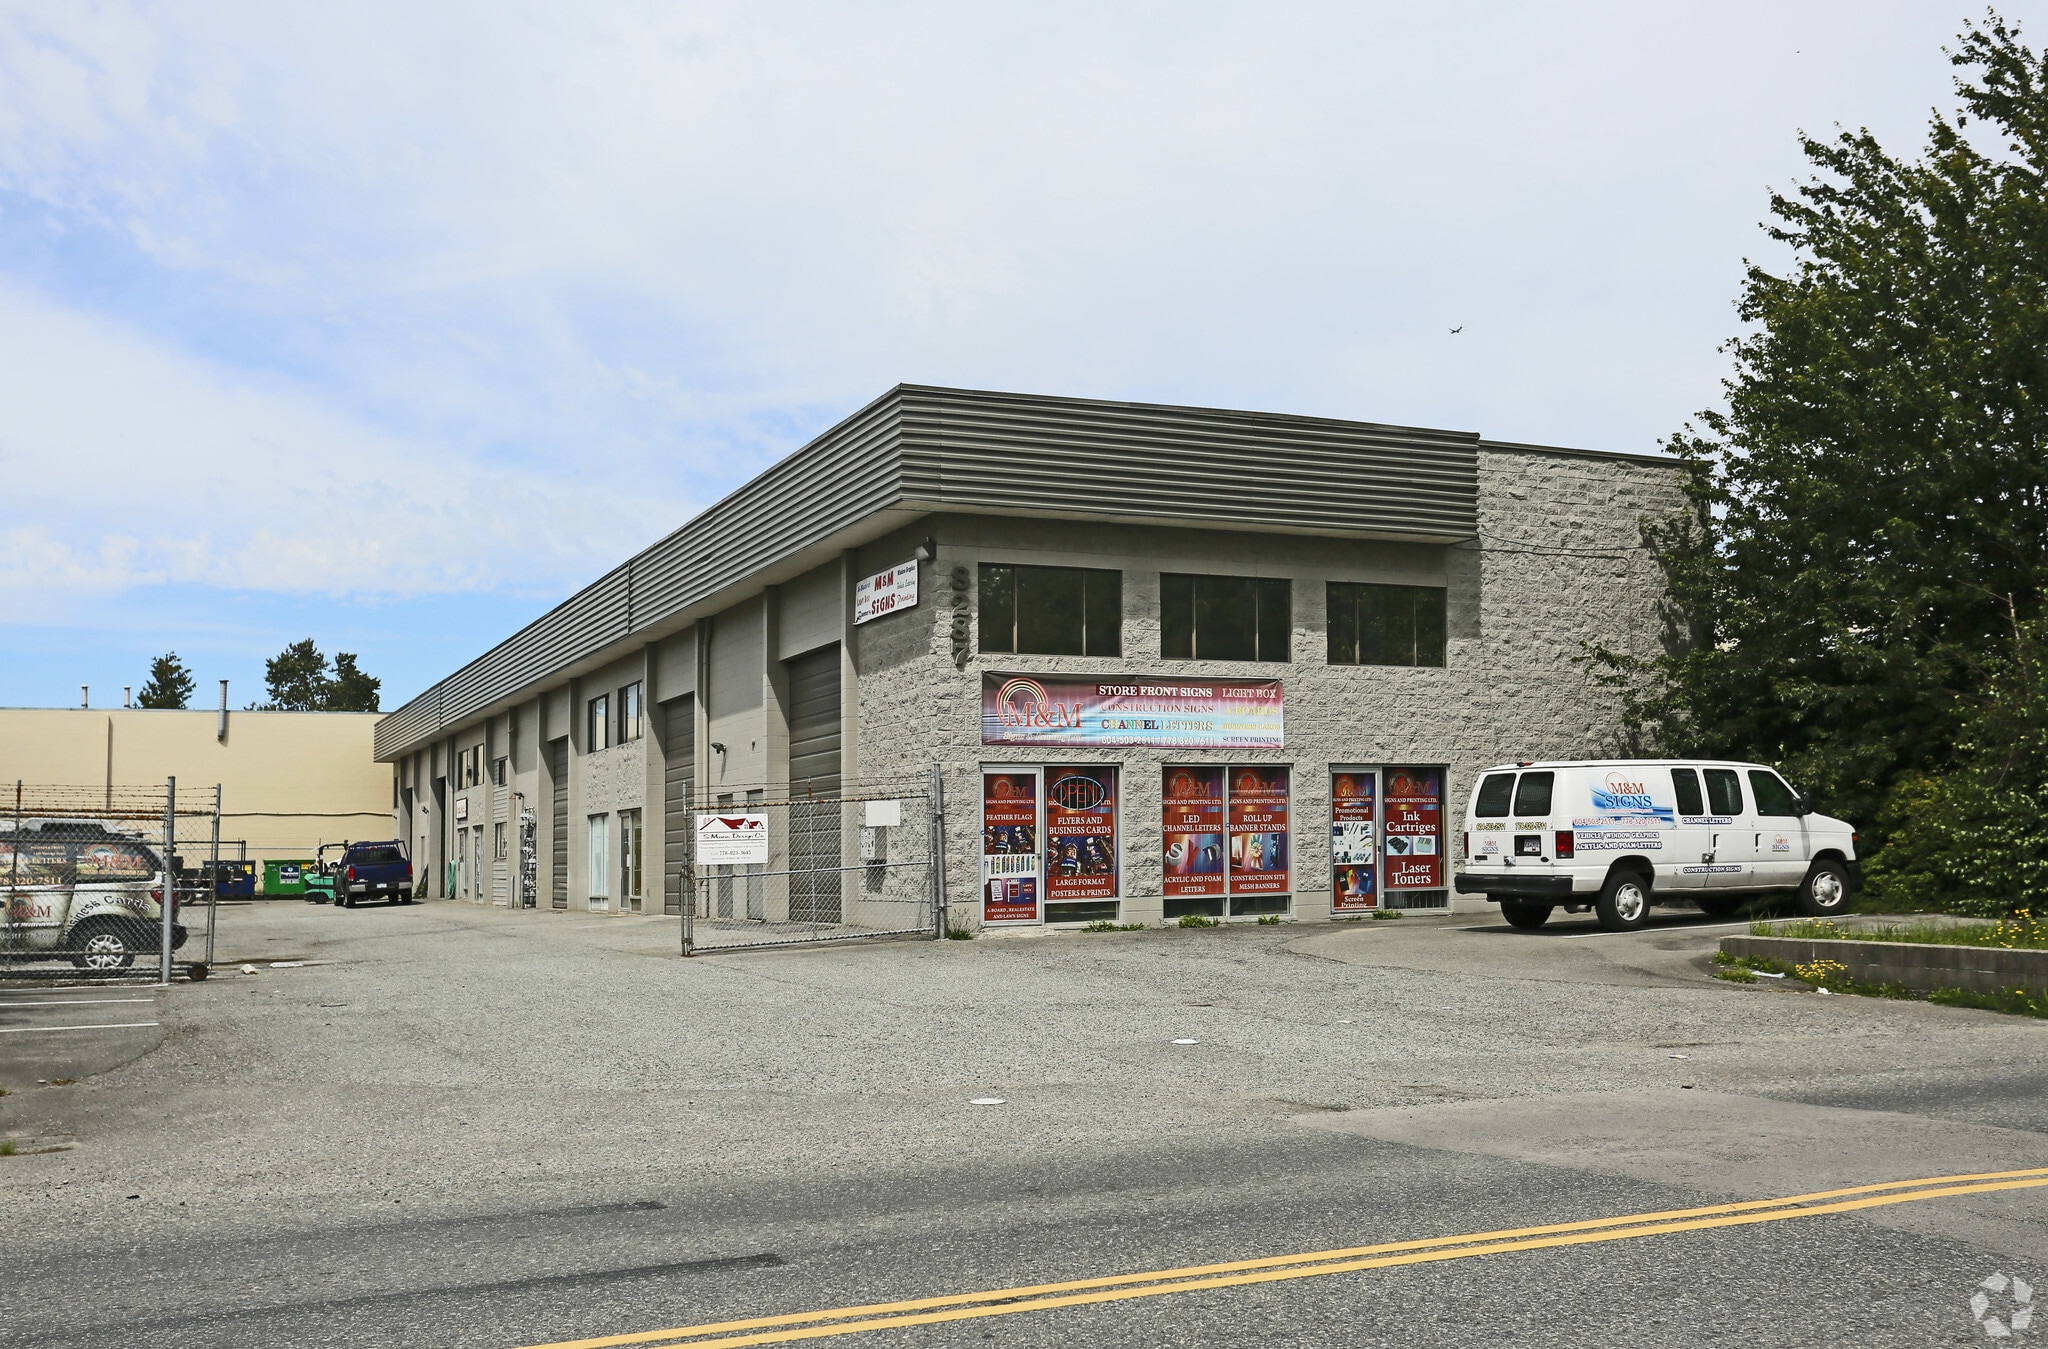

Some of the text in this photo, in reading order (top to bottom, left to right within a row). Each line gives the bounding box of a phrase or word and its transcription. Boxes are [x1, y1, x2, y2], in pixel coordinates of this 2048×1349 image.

[1099, 685, 1213, 697] STORE FRONT SIGNS
[1222, 688, 1277, 698] LIGHT BOX
[1101, 703, 1214, 713] CONSTRUCTION SIGNS
[1004, 701, 1084, 728] M&M
[1101, 719, 1213, 731] CHANNEL LETTERS
[1054, 784, 1099, 803] OPEN
[1611, 783, 1645, 794] M&M
[1605, 796, 1652, 808] SIGNS
[1057, 816, 1103, 825] FLYERS AND
[1183, 815, 1200, 823] LED
[1243, 815, 1262, 823] ROLL
[1403, 811, 1421, 821] Ink
[1049, 825, 1112, 835] BUSINESS CARDS
[1386, 821, 1436, 835] Cartriges
[1575, 842, 1604, 850] ACRYLIC
[1401, 861, 1431, 873] Laser
[1392, 872, 1431, 885] Toners
[103, 896, 151, 911] Cards
